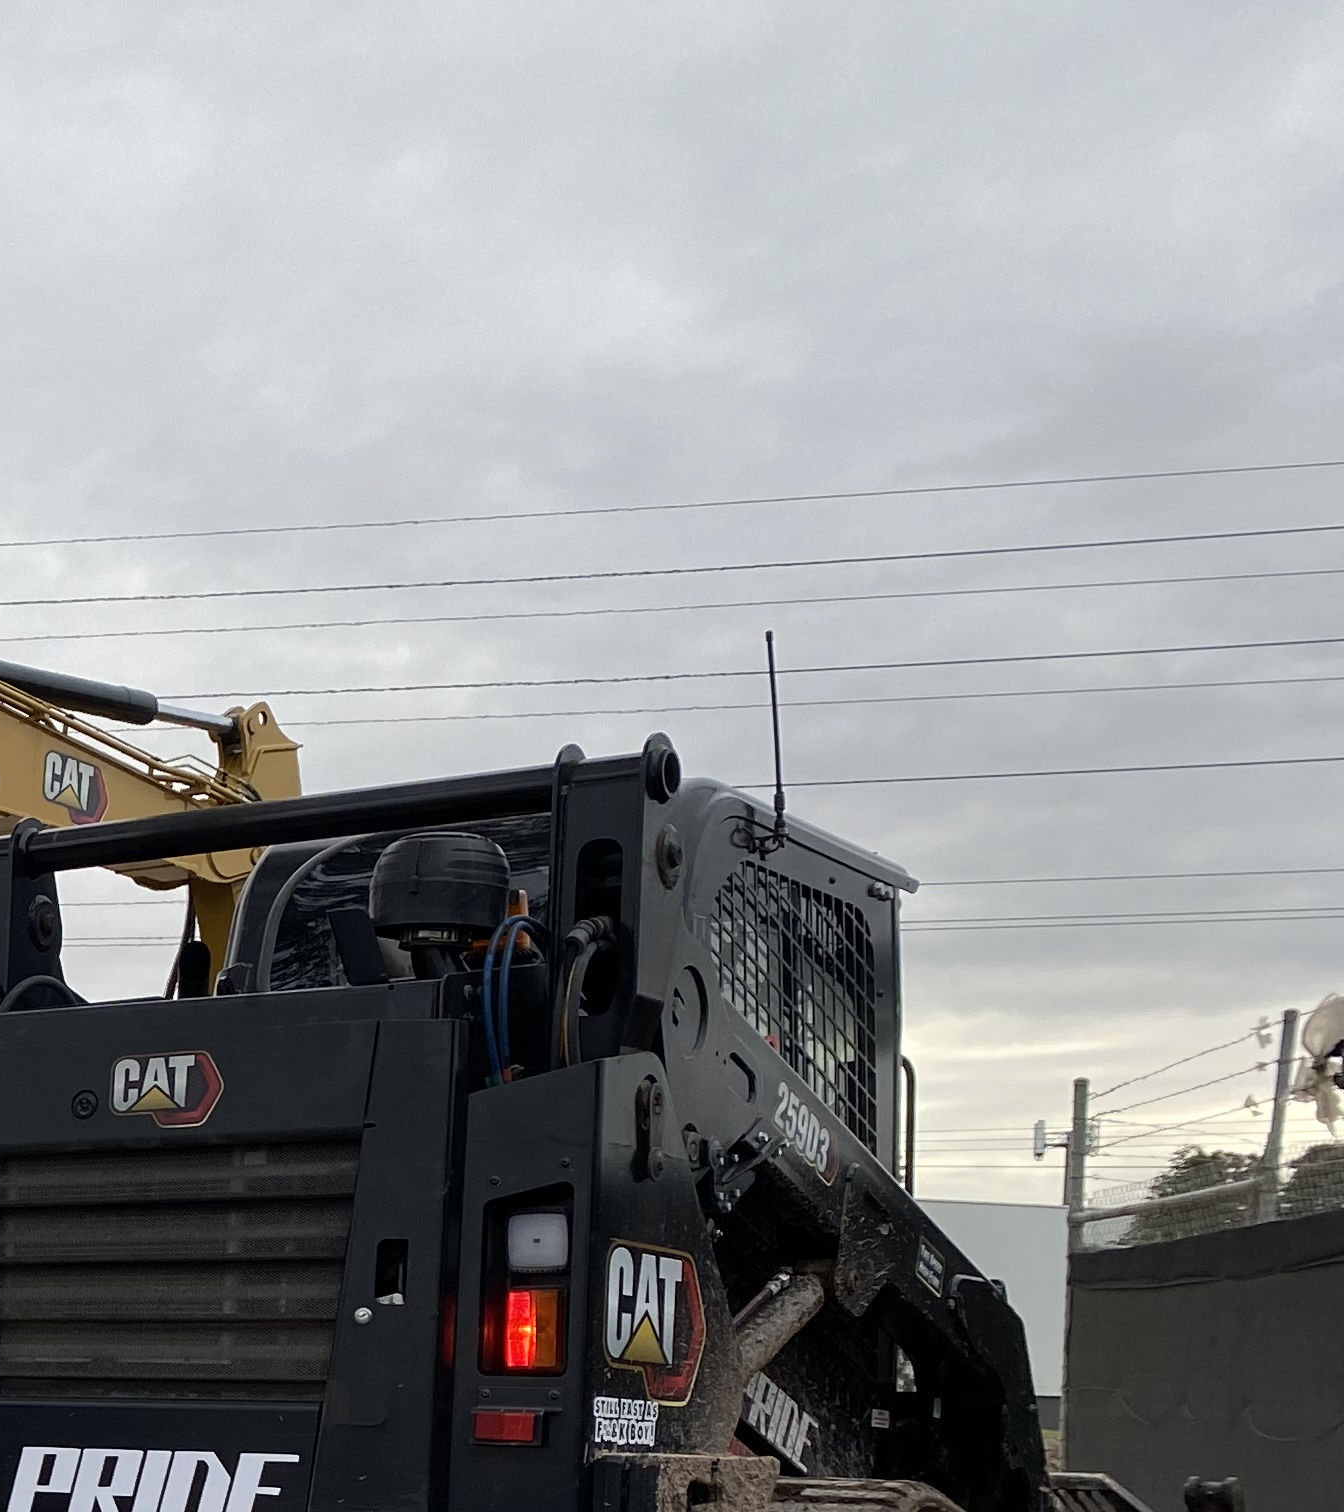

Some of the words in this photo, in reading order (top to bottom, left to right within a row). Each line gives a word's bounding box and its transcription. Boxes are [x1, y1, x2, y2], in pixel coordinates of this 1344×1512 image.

[44, 751, 95, 811] CAT
[113, 1054, 196, 1111] CAT
[606, 1246, 683, 1369] CAT
[595, 1399, 618, 1415] STILL
[621, 1401, 643, 1417] FAST
[646, 1403, 658, 1418] AS
[630, 1423, 654, 1442] BOY!
